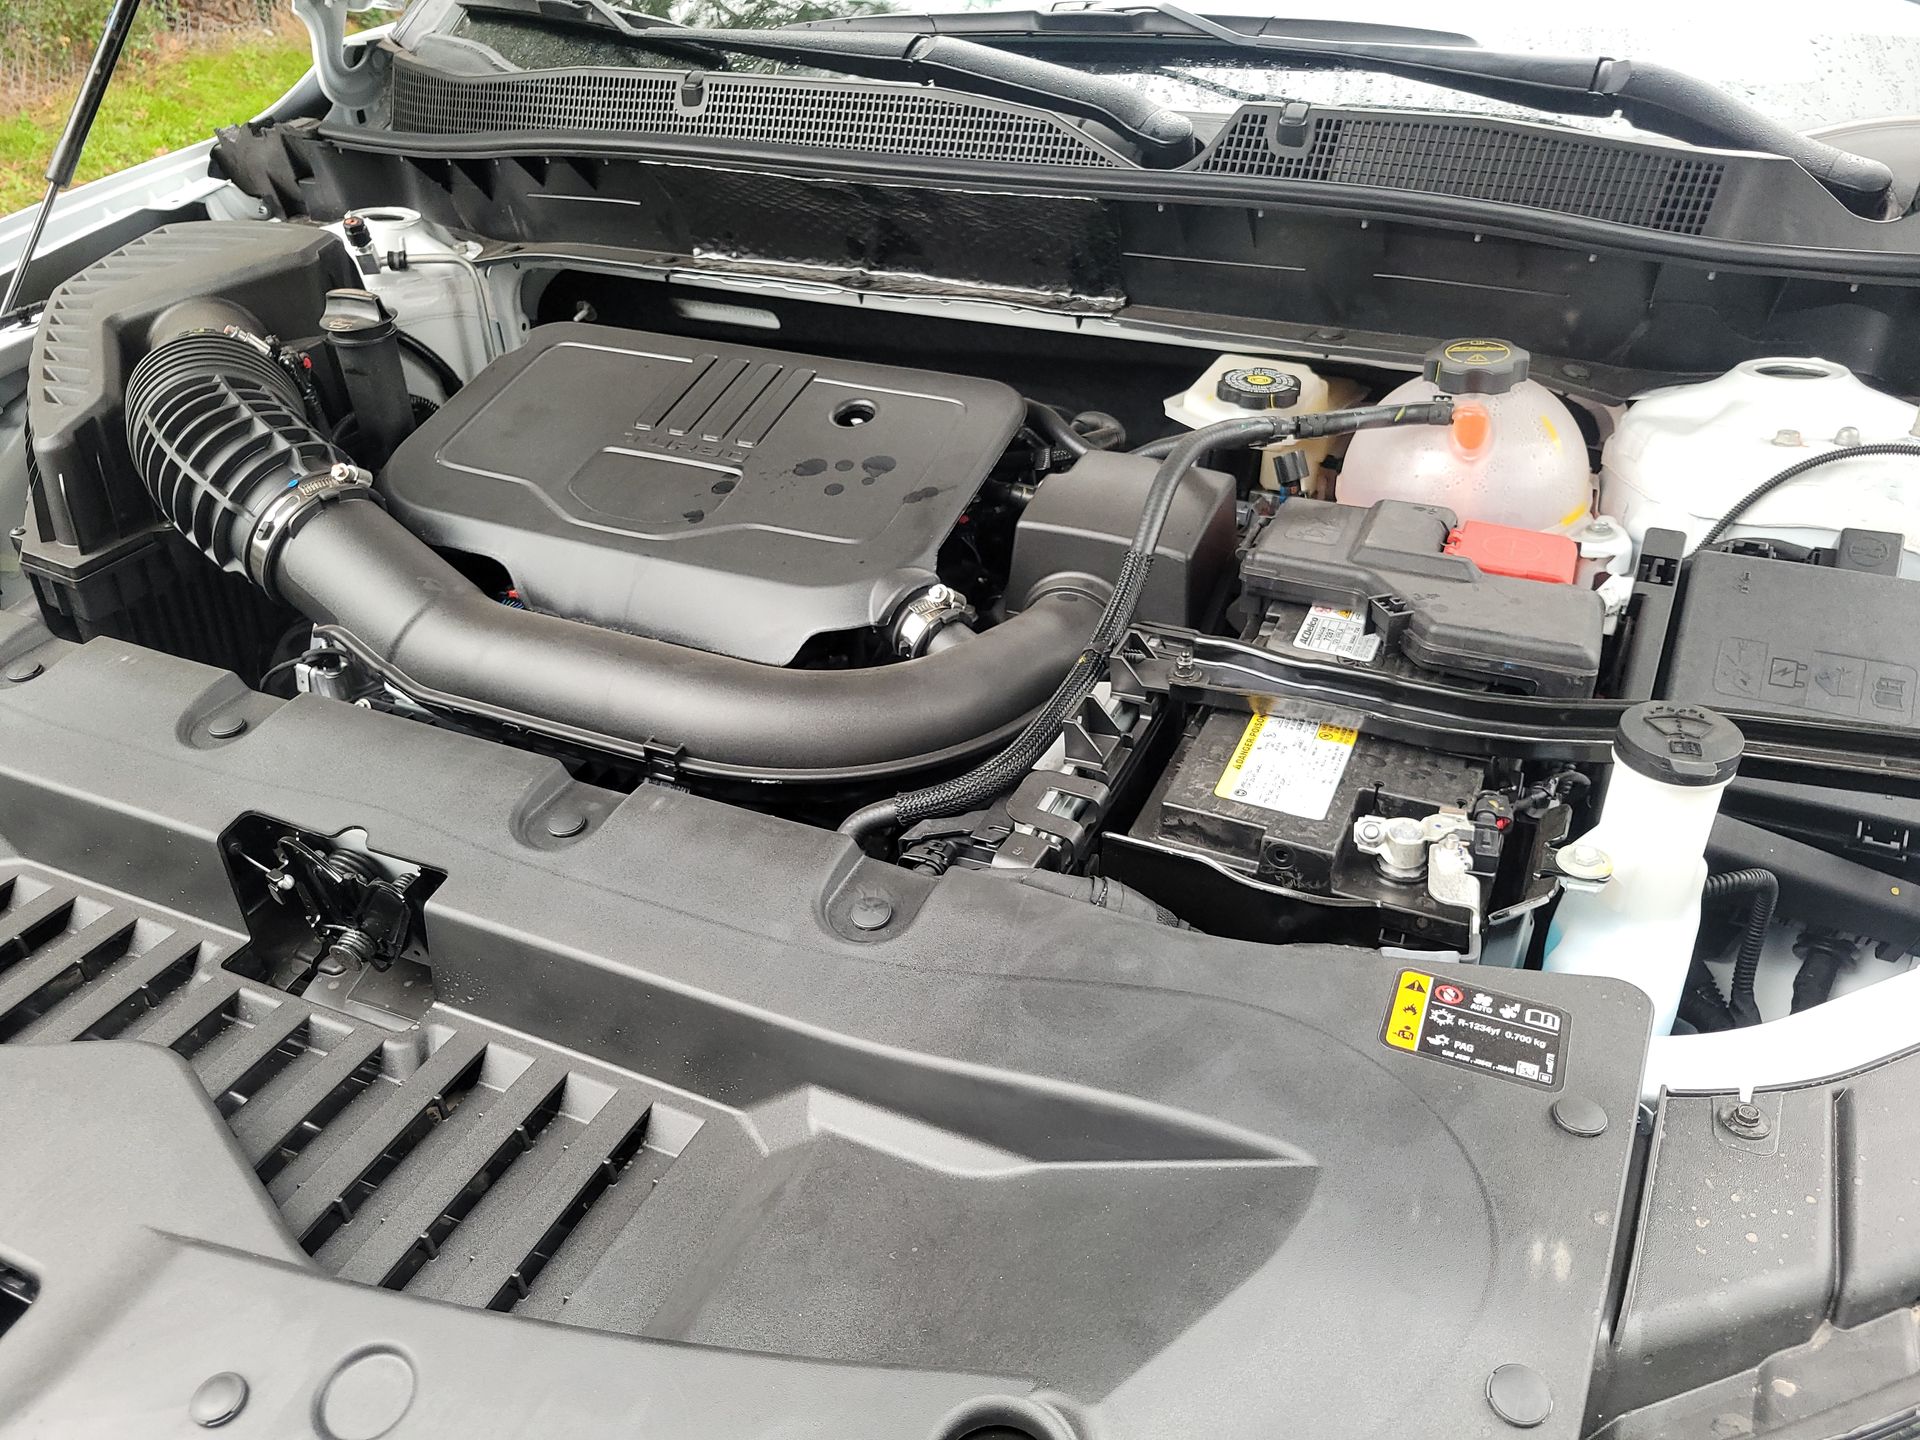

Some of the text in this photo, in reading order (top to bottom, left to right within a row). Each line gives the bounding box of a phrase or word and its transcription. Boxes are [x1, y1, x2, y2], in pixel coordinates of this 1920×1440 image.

[1300, 616, 1319, 645] ACDelco
[1469, 1003, 1493, 1014] AUTO
[1457, 1018, 1547, 1049] R-1234yf 0.700 kg
[1453, 1040, 1474, 1053] PAG
